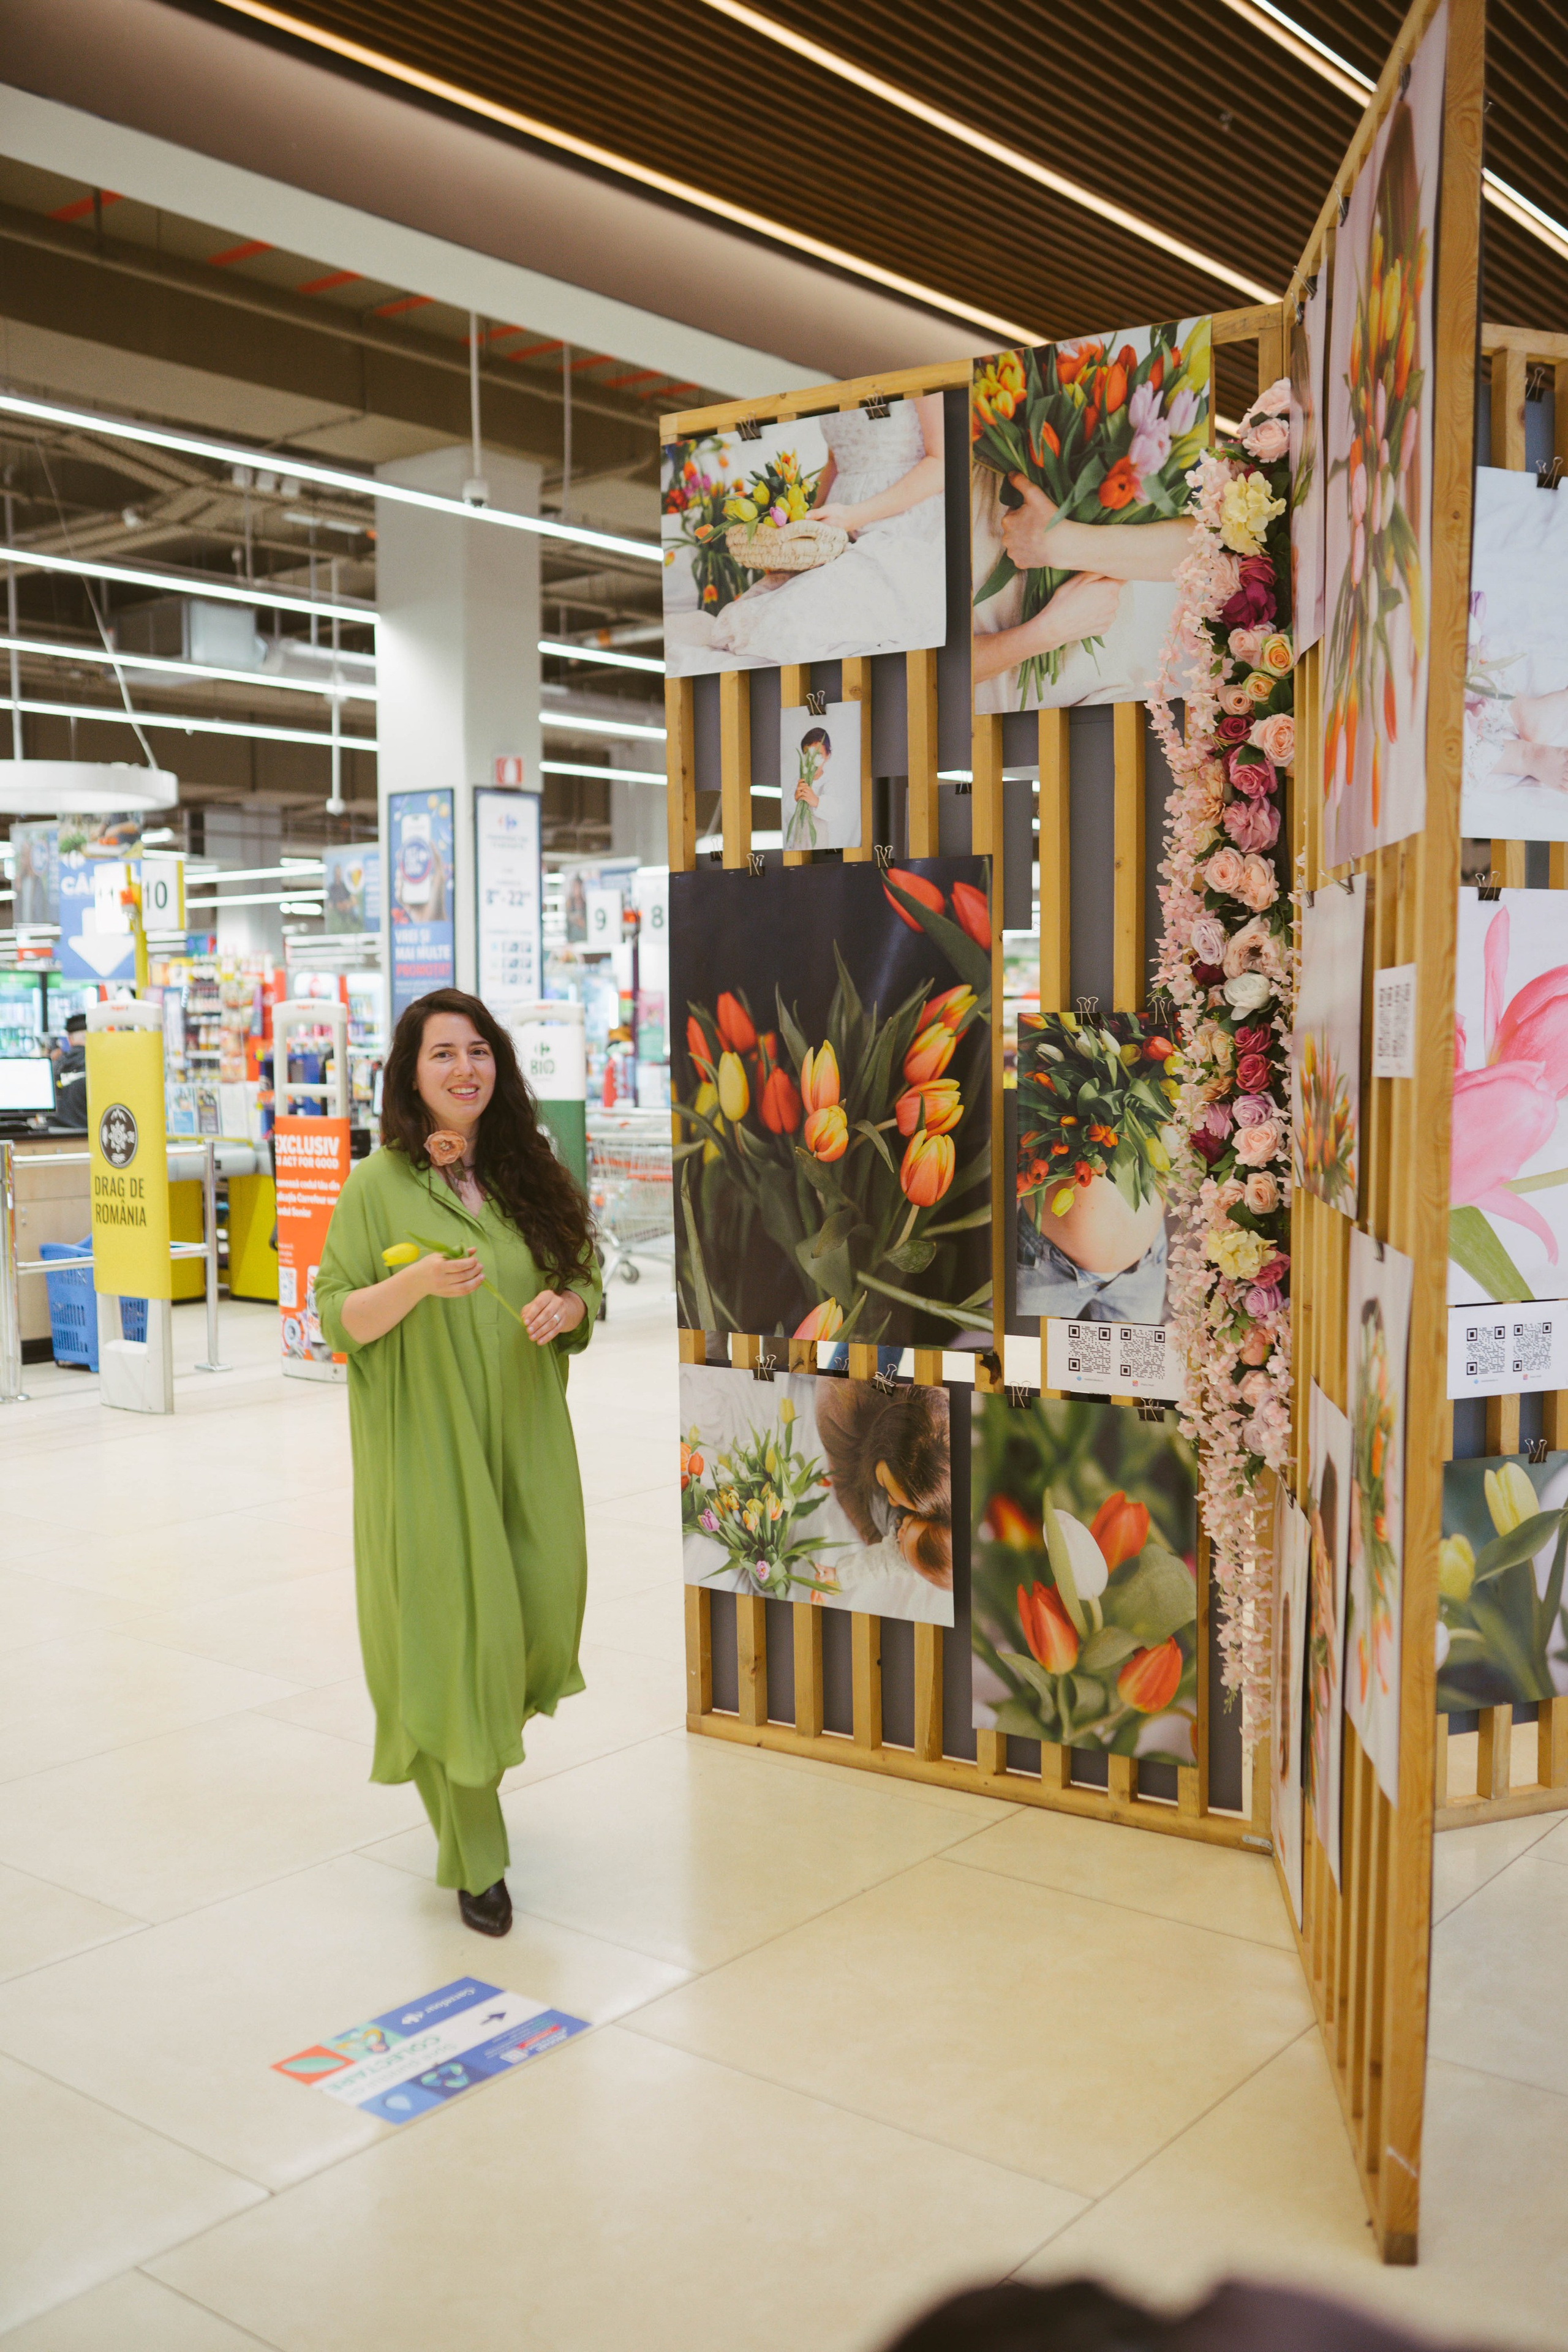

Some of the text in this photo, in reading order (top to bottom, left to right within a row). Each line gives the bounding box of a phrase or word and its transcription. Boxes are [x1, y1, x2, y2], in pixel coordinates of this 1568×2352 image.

[145, 881, 168, 909] 10
[595, 908, 606, 930] 9
[651, 905, 664, 929] 8
[274, 1134, 340, 1157] EXCLUSIV
[282, 1156, 297, 1167] ACT
[298, 1156, 314, 1168] FOR
[315, 1157, 339, 1169] GOOD
[95, 1175, 145, 1199] DRAG DE
[96, 1199, 146, 1226] ROMÂNIA
